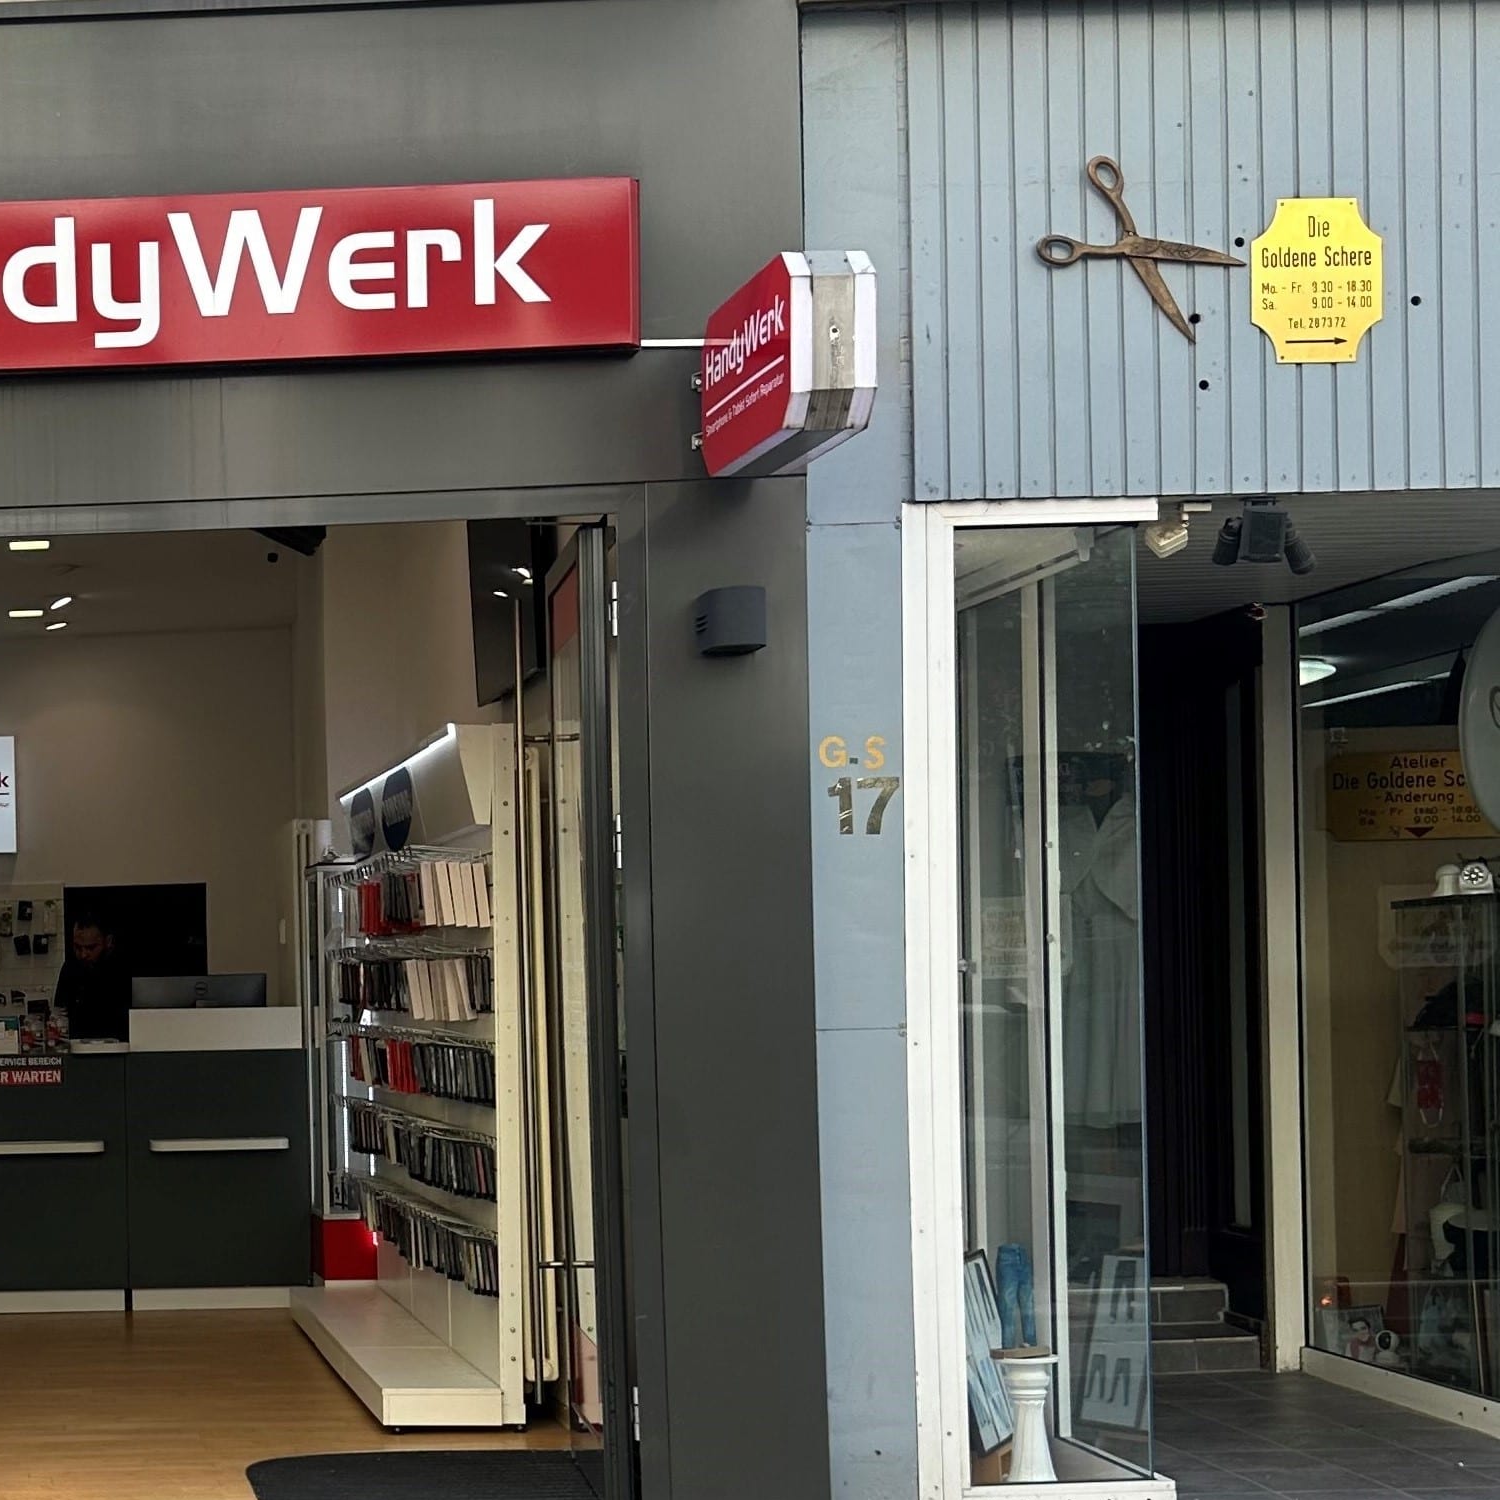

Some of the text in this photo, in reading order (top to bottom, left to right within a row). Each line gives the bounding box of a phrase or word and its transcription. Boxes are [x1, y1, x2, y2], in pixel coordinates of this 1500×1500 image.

[1308, 215, 1330, 238] Die
[1261, 246, 1372, 268] Goldene Schere
[1346, 280, 1372, 292] 18.30
[1311, 297, 1333, 309] 9.00
[1346, 296, 1372, 308] 14.00
[706, 294, 785, 391] HandyWerk
[1390, 755, 1447, 769] Atelier
[1332, 772, 1360, 790] Die
[1366, 771, 1437, 789] Goldene
[826, 775, 900, 835] 17
[28, 1056, 62, 1066] BEREICH
[11, 1069, 61, 1083] WARTEN
